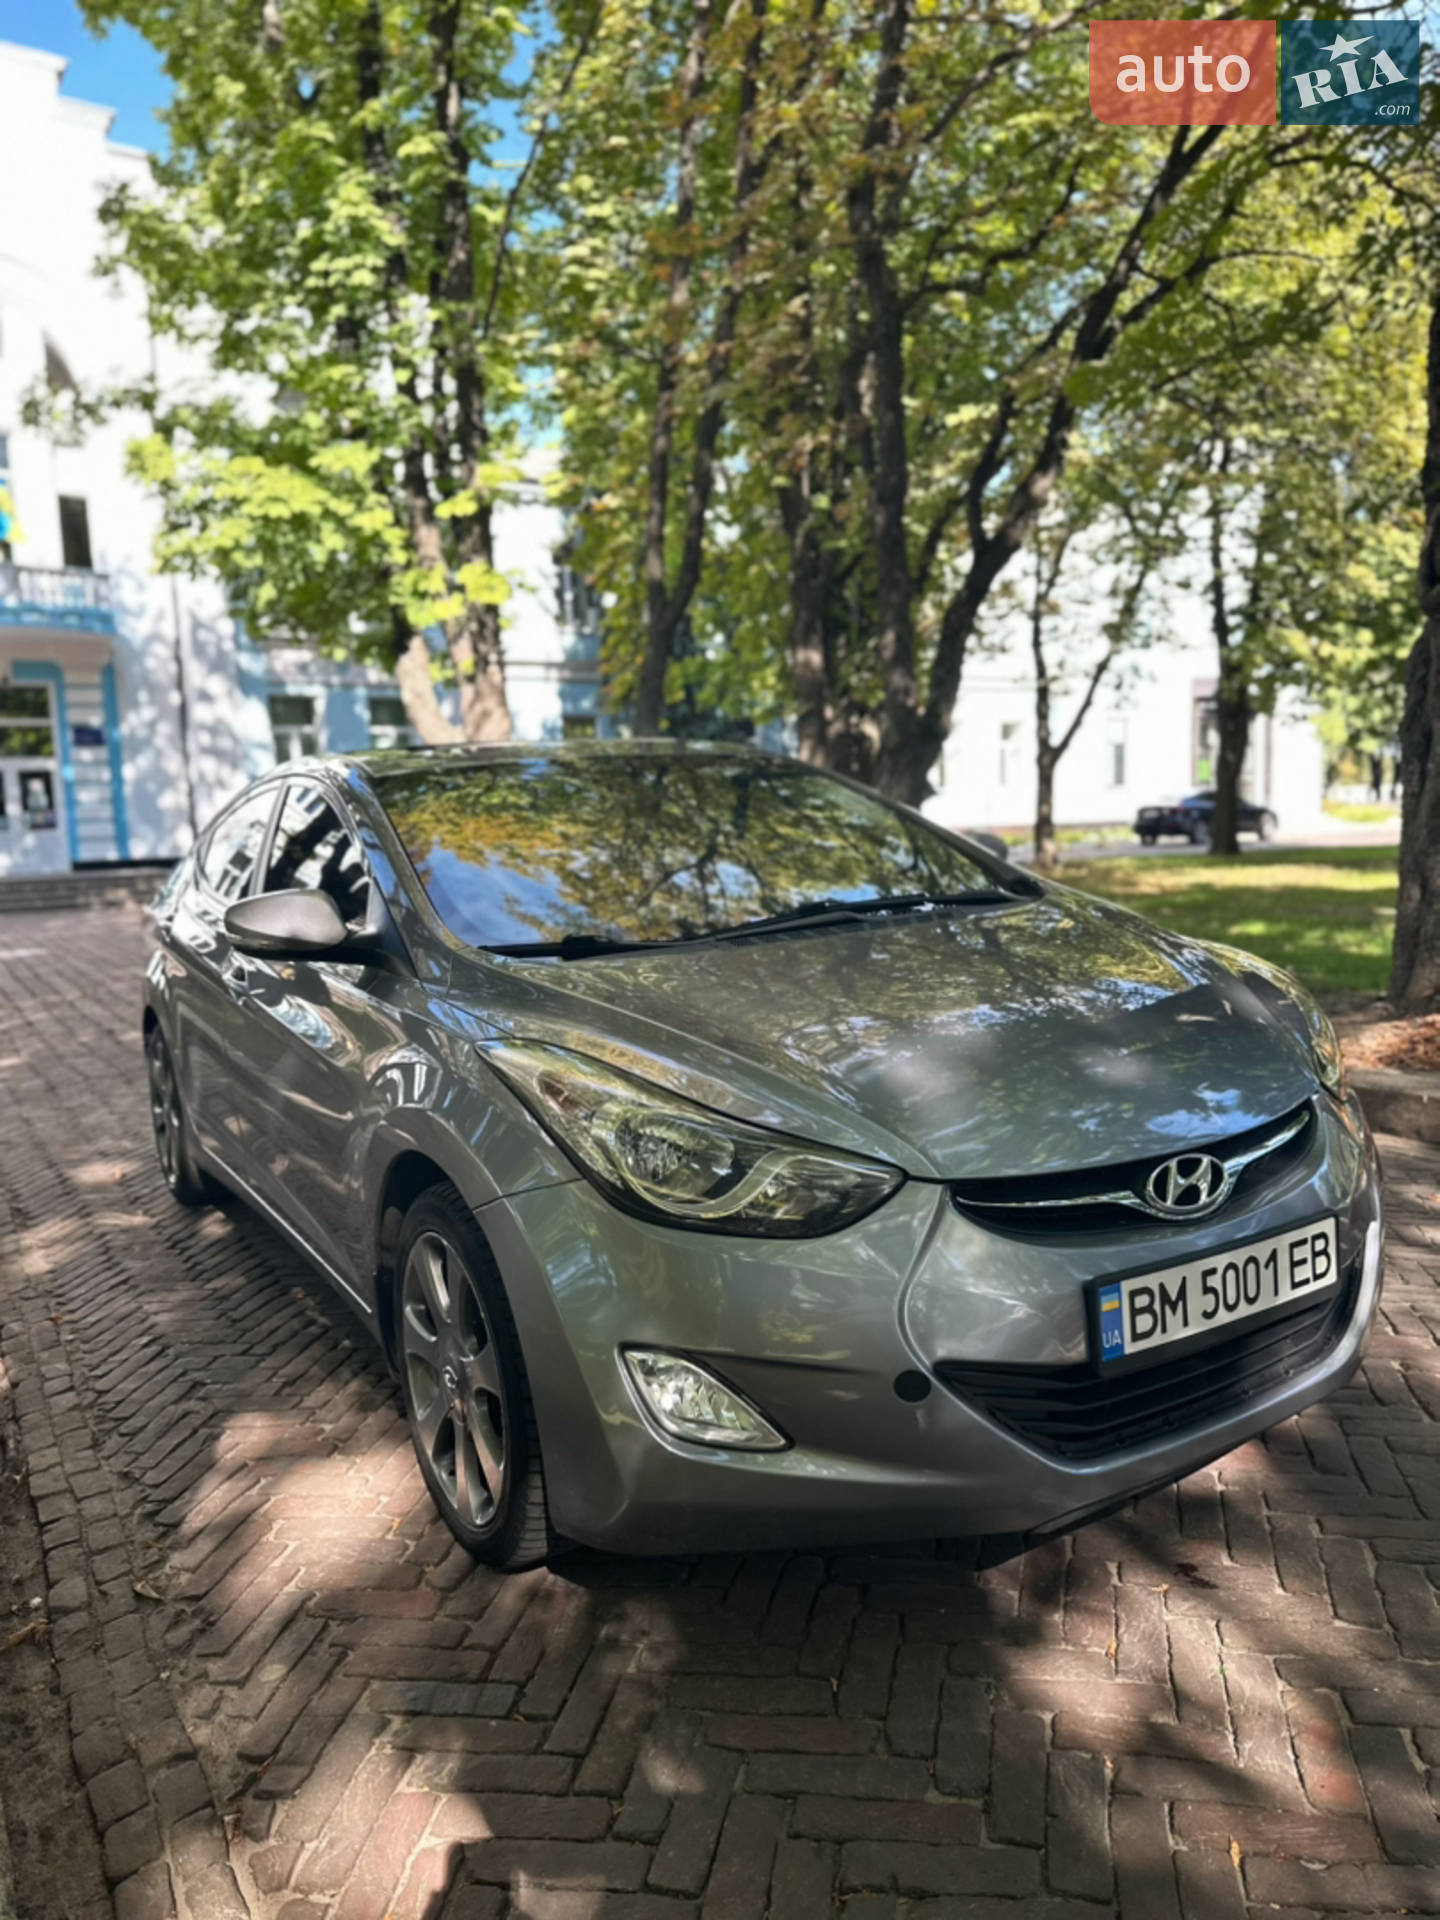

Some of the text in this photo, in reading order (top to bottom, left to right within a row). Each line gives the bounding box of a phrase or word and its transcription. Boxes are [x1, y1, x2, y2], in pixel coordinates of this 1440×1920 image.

[1128, 1231, 1332, 1343] BM 5001 EB
[1102, 1332, 1122, 1348] UA
